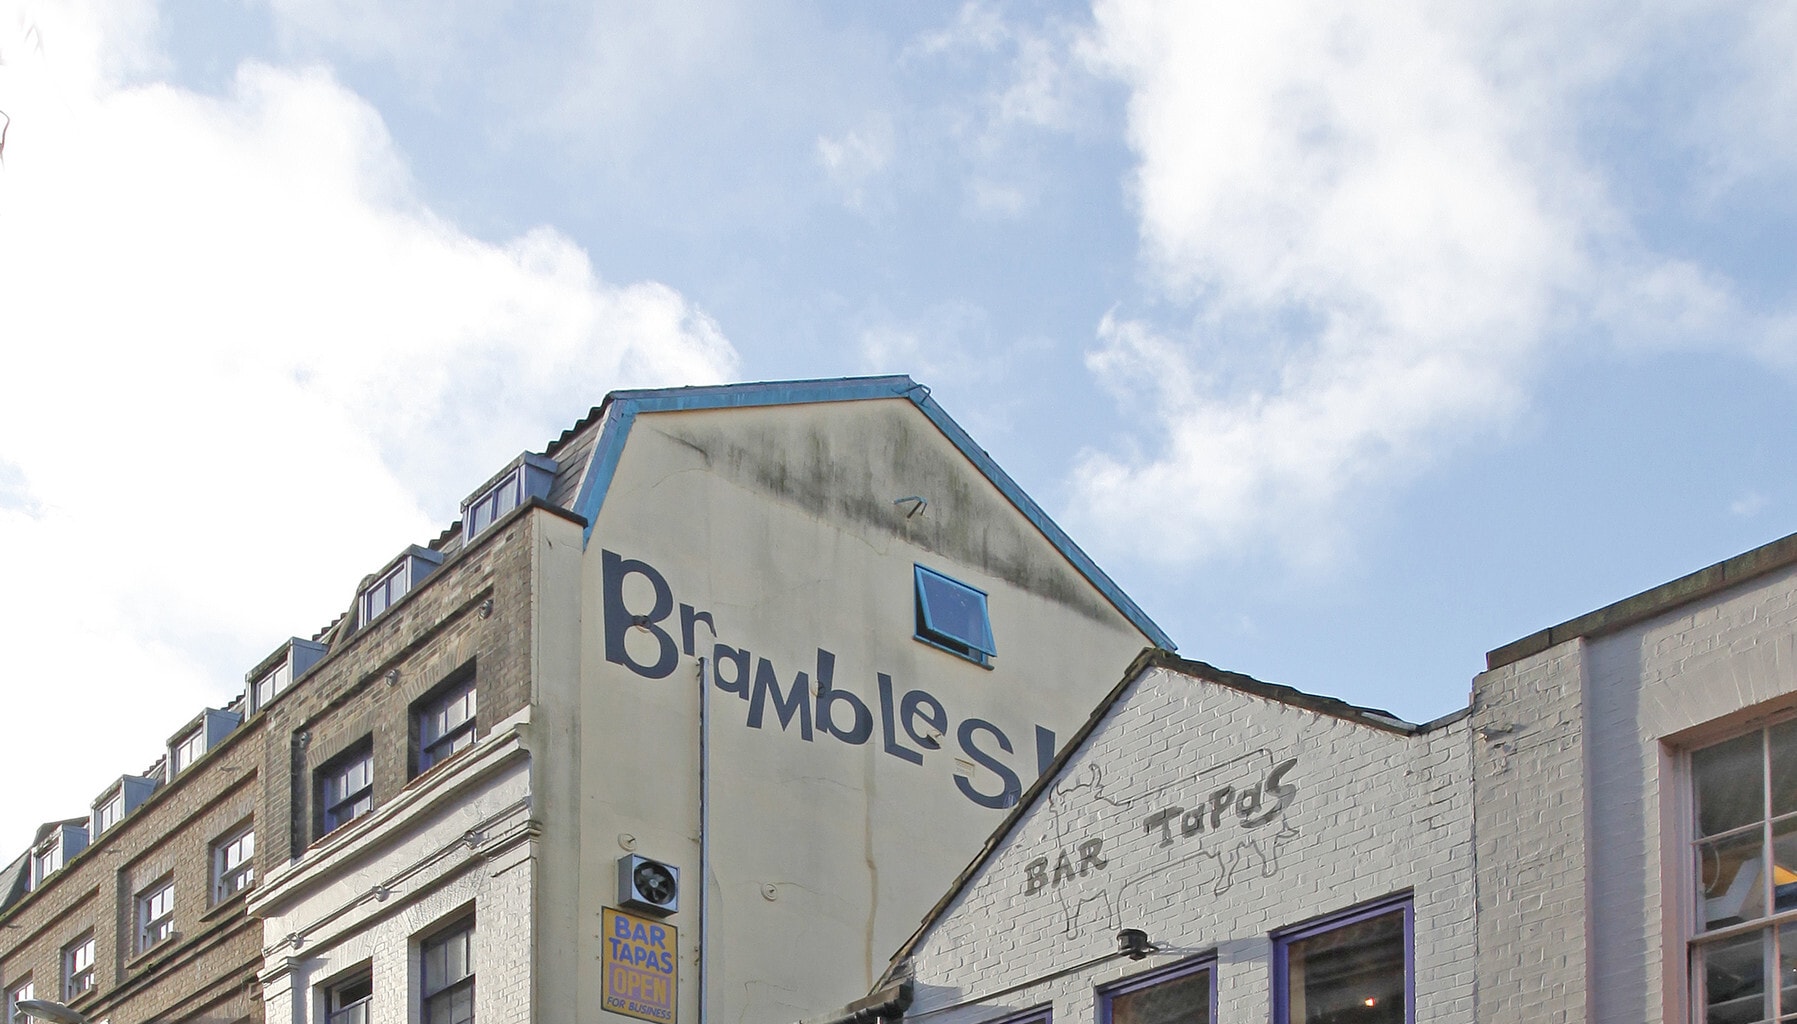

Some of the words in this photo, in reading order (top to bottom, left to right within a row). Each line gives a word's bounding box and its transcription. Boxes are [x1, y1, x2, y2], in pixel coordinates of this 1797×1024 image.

[1023, 837, 1109, 898] BAR
[614, 915, 666, 950] BAR
[608, 937, 673, 974] TAPAS
[613, 967, 667, 1008] OPEN
[606, 996, 626, 1009] FOR
[628, 1002, 672, 1020] BUSINESS
